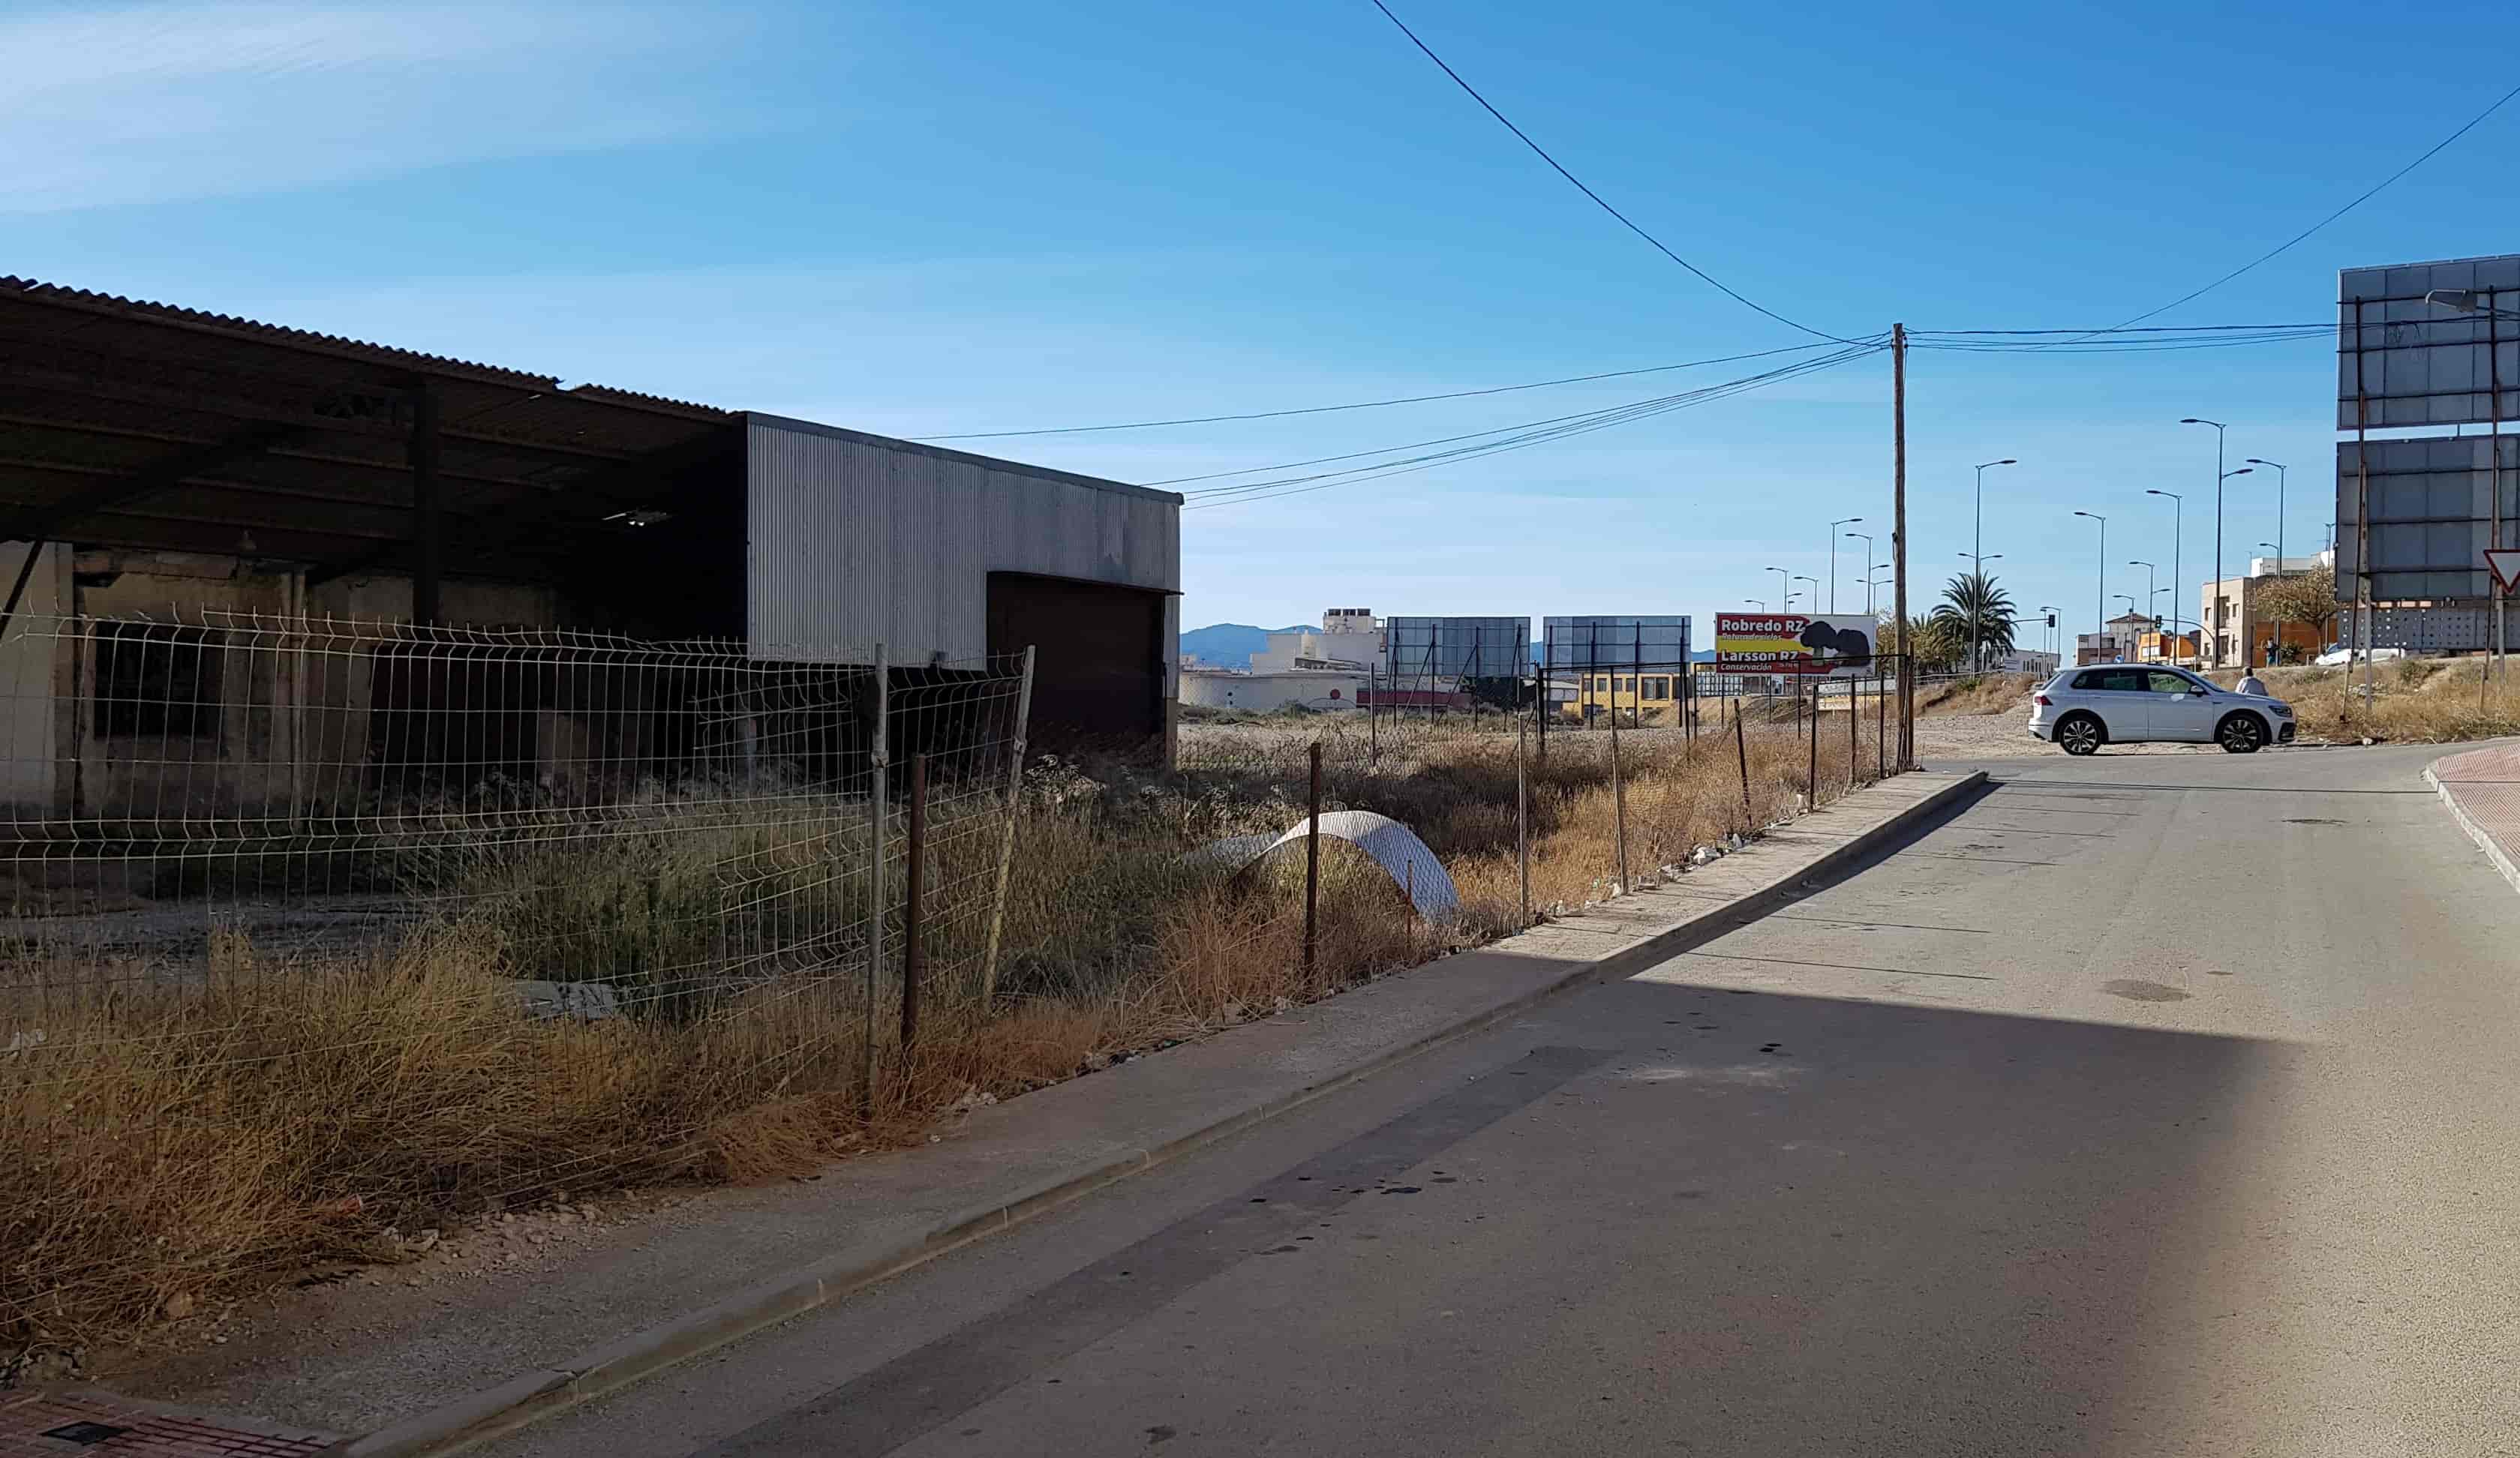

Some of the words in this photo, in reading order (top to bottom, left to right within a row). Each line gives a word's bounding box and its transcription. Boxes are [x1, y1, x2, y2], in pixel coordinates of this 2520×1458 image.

[1722, 619, 1782, 632] Robredo
[1785, 620, 1804, 632] RZ
[1721, 650, 1777, 662] Larsson
[1721, 662, 1772, 671] Conservación
